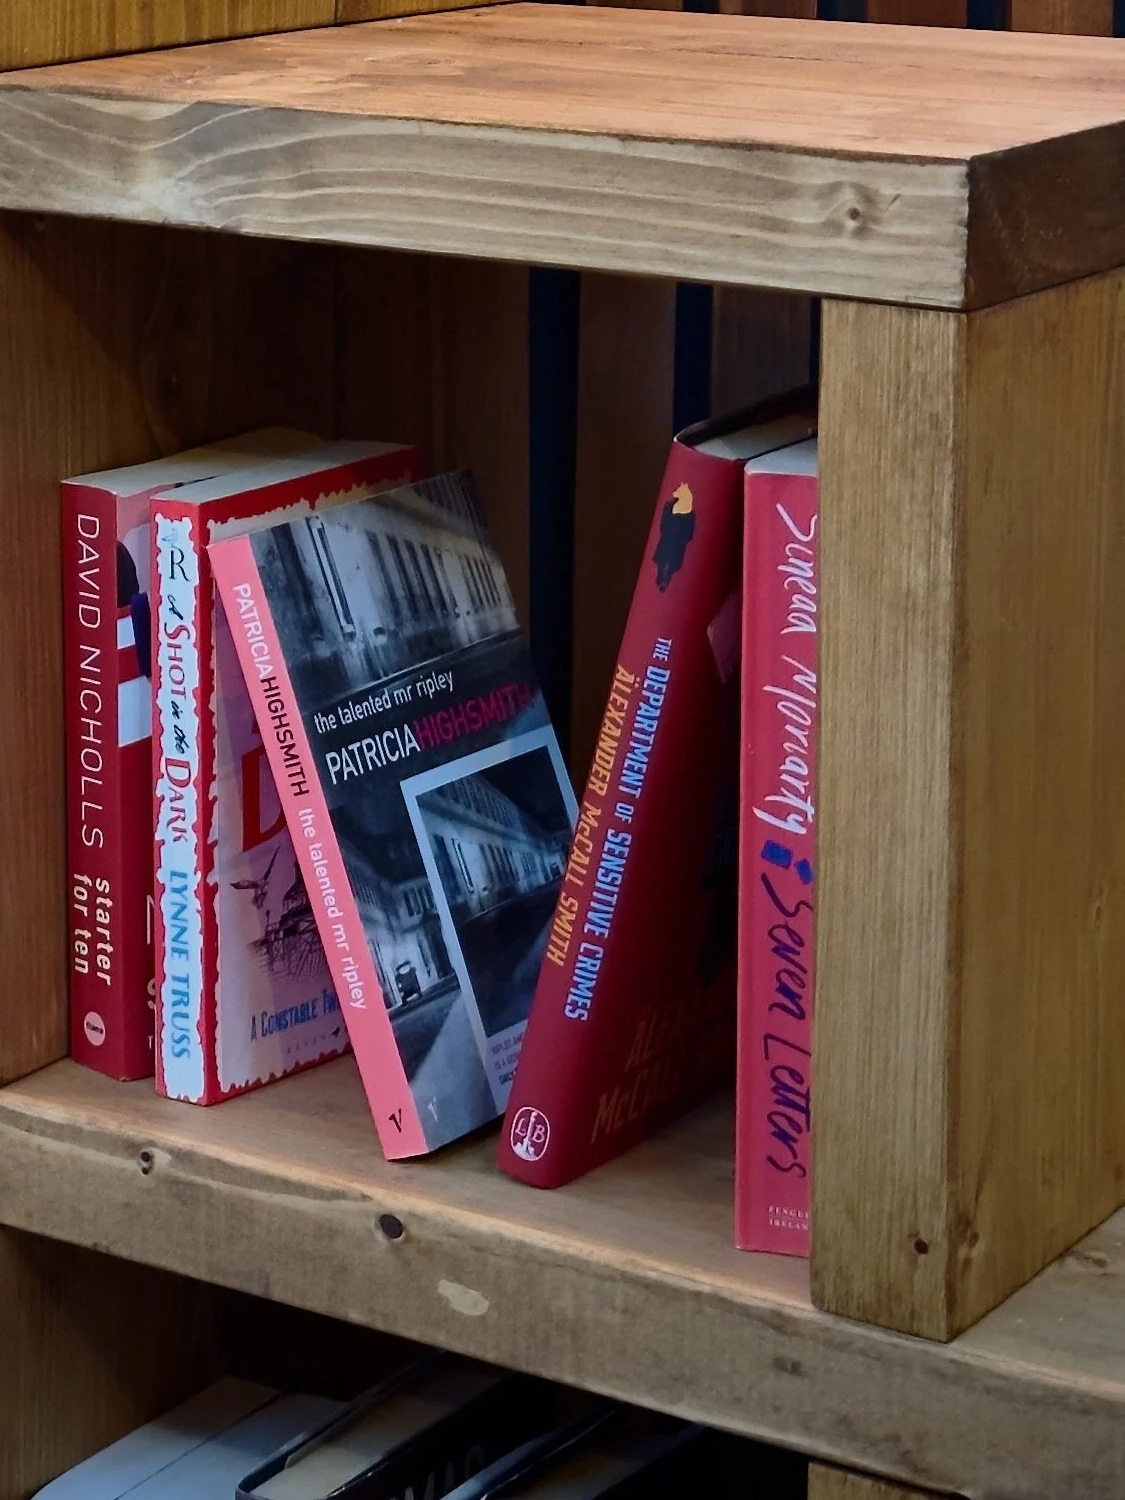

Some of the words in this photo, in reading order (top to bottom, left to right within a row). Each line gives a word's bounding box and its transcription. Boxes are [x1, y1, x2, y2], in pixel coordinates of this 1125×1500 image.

[76, 513, 102, 630] DAVID
[163, 621, 191, 700] SHOT
[651, 635, 674, 663] THE
[313, 713, 337, 735] the
[338, 692, 392, 726] talented
[392, 684, 413, 706] mr
[415, 670, 454, 700] ripley
[618, 664, 671, 799] DEPARTMENT
[78, 644, 105, 849] NICHOLLS
[163, 756, 193, 844] DARK
[297, 808, 316, 840] the
[614, 801, 635, 825] OF
[307, 842, 344, 919] talented
[563, 800, 603, 888] McCALL
[583, 827, 632, 939] SENSITIVE
[73, 872, 92, 917] for
[95, 877, 115, 988] starter
[168, 869, 190, 962] LYNNE
[546, 890, 579, 968] SMITH
[74, 928, 90, 975] ten
[331, 923, 351, 954] mr
[761, 871, 814, 1022] Seven
[169, 973, 192, 1061] TRUSS
[250, 1014, 258, 1043] A
[260, 997, 320, 1037] CONSTABLE
[340, 955, 368, 1011] ripley
[563, 940, 604, 1022] CRIMES
[762, 1032, 813, 1179] Letters
